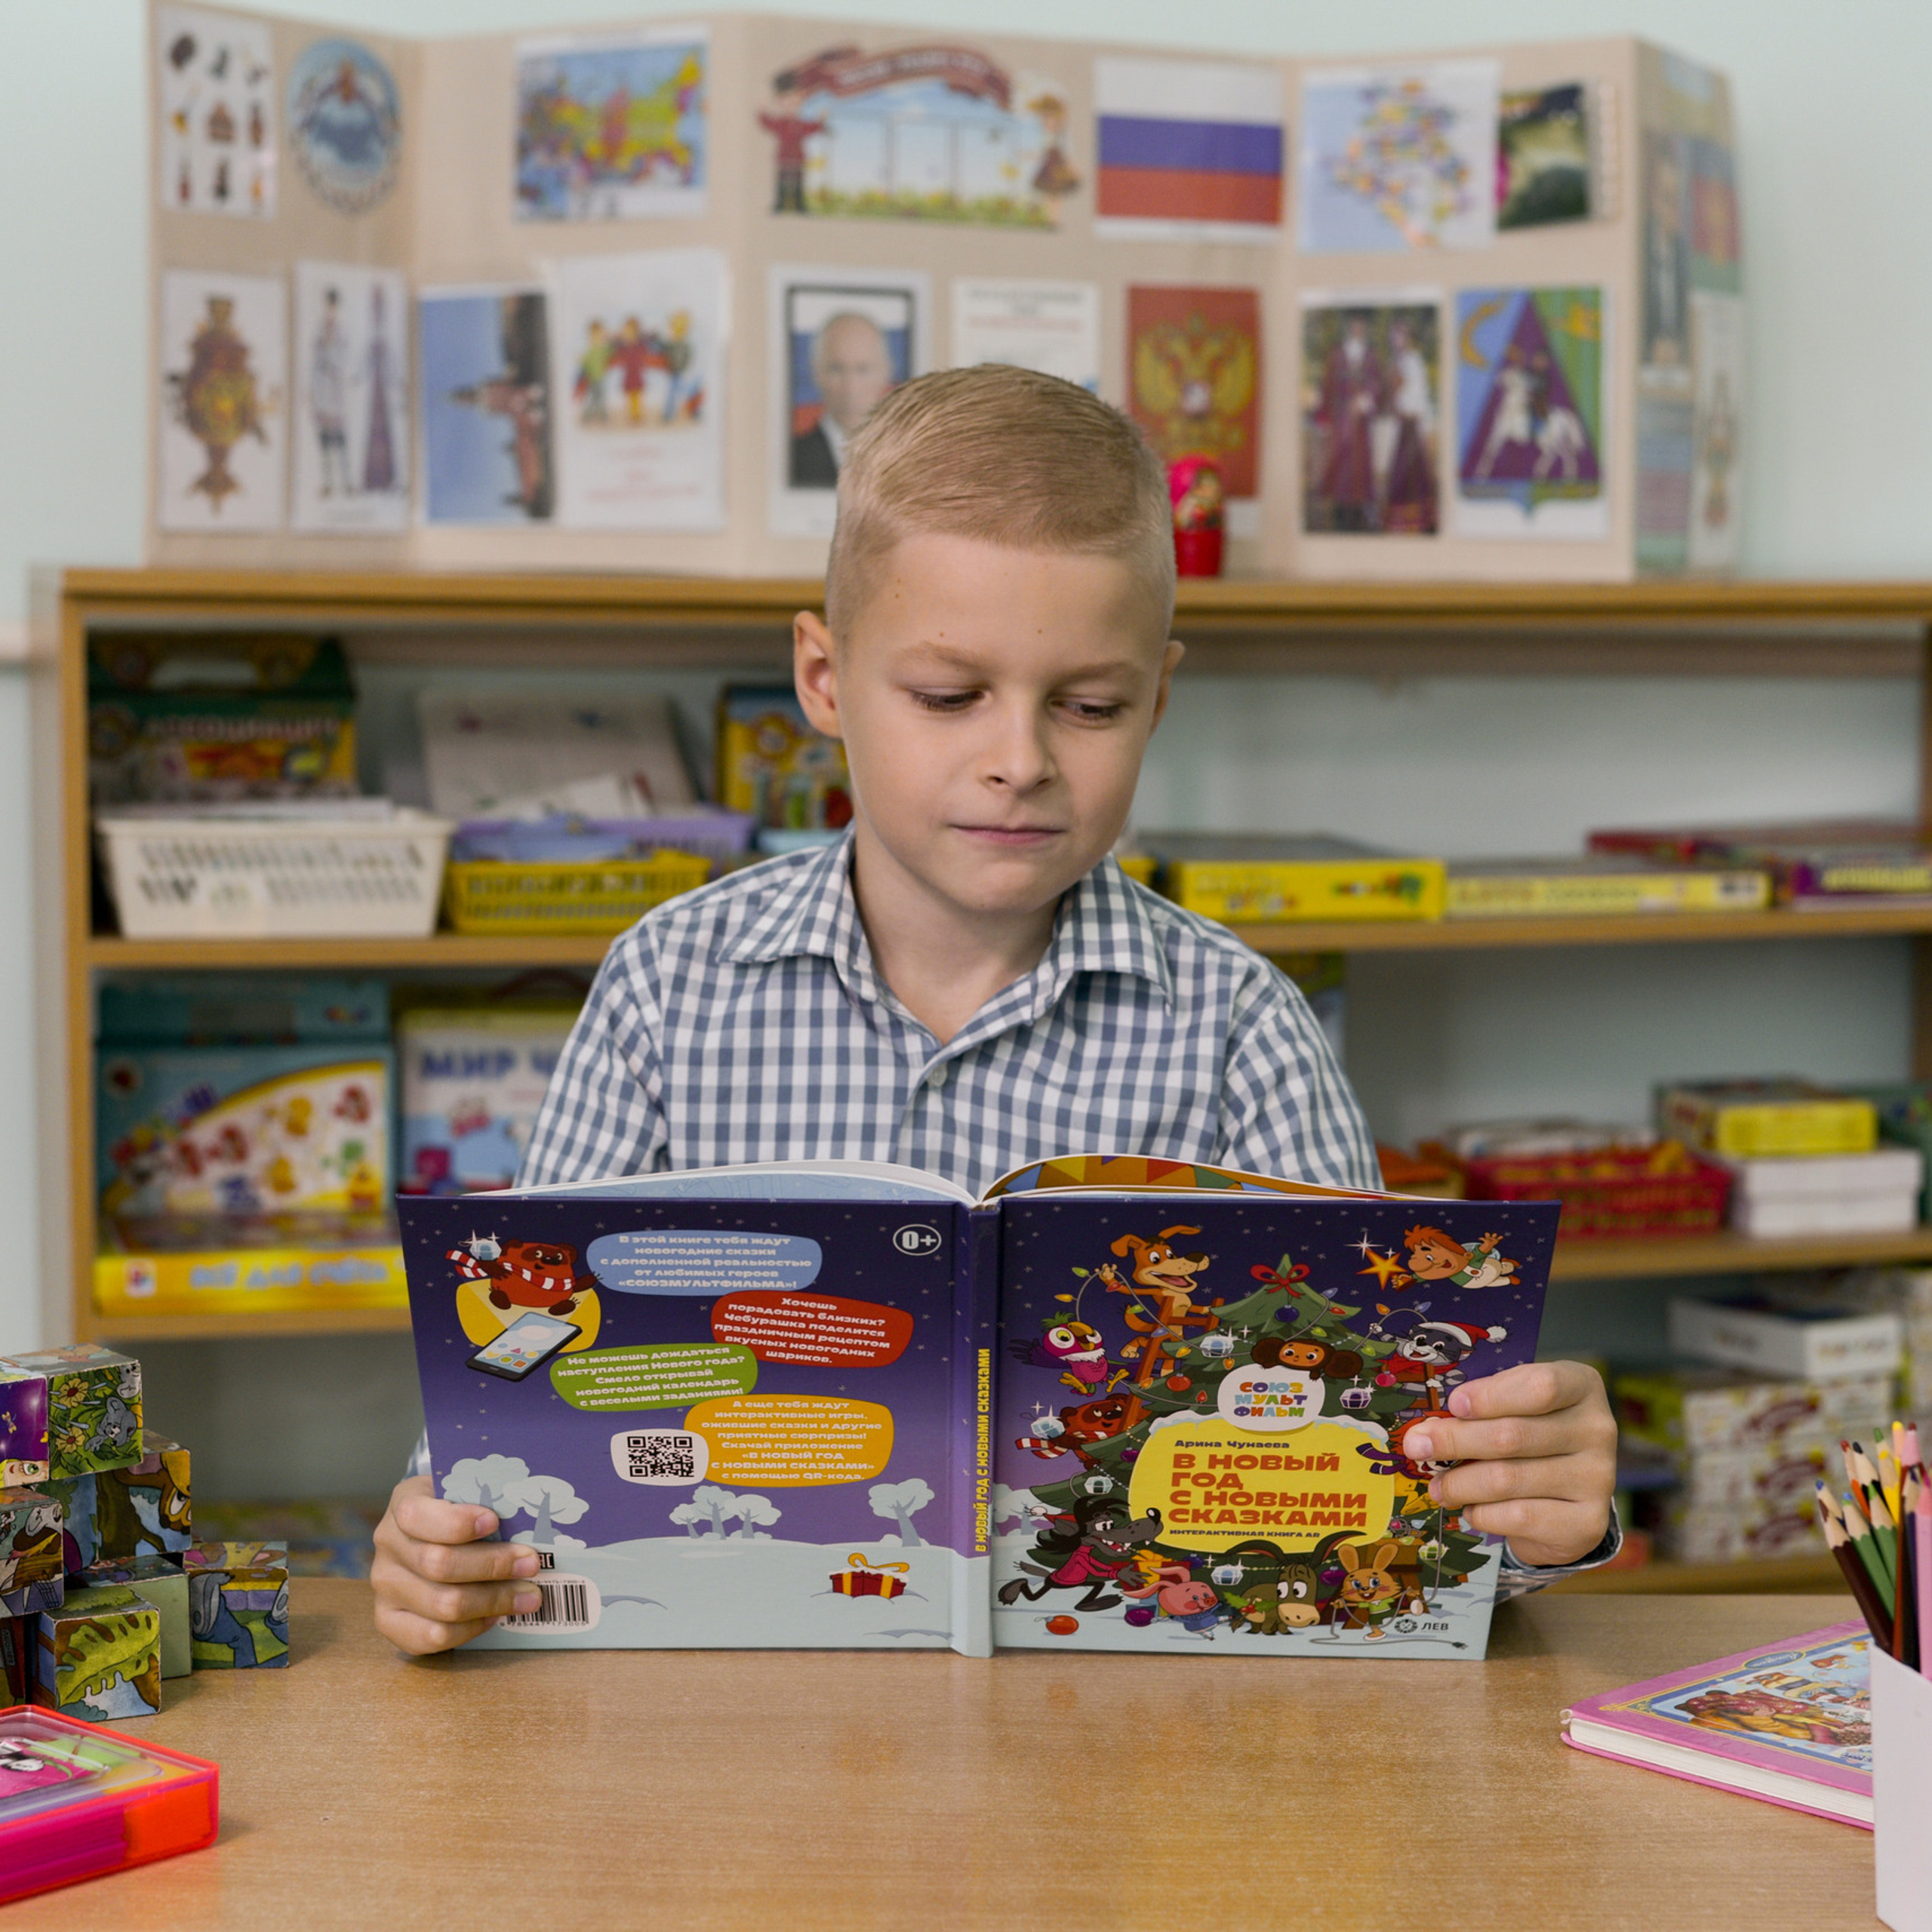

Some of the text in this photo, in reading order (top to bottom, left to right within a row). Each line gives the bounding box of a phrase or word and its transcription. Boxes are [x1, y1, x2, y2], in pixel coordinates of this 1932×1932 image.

[632, 1235, 666, 1244] этой
[669, 1236, 711, 1244] книге
[714, 1235, 748, 1244] тебя
[751, 1237, 791, 1245] ждут
[902, 1231, 937, 1250] 0+
[611, 1258, 711, 1266] дополненной
[714, 1259, 812, 1267] реальностью
[655, 1269, 724, 1277] любимых
[728, 1270, 779, 1278] героев
[782, 1297, 837, 1310] Хочешь
[728, 1303, 885, 1326] порадовать близких?
[724, 1312, 885, 1337] Чебурашка поделится
[714, 1324, 891, 1349] праздничным рецептом
[724, 1335, 875, 1357] вкусных новогодних
[568, 1347, 730, 1365] Не можешь дождаться
[766, 1350, 832, 1364] шариков.
[558, 1355, 745, 1377] наступления Нового года?
[595, 1368, 713, 1384] Смело открывай
[576, 1377, 739, 1396] новогодний календарь
[1239, 1382, 1303, 1393] СОЮЗ
[590, 1394, 660, 1406] веселыми
[663, 1388, 743, 1401] заданиями!
[812, 1401, 849, 1410] ждут
[1235, 1395, 1307, 1405] МУЛЬТ
[1233, 1406, 1305, 1417] ФИЛЬМ
[832, 1423, 881, 1431] другие
[977, 1414, 989, 1466] НОВЫМИ
[1175, 1440, 1290, 1449] Арина Чунаева
[761, 1451, 813, 1460] НОВЫЙ
[1173, 1452, 1340, 1472] В НОВЫЙ
[977, 1468, 989, 1476] С
[976, 1477, 990, 1501] ГОД
[1171, 1472, 1243, 1490] ГОД
[1170, 1490, 1367, 1509] С НОВЫМИ
[974, 1503, 989, 1542] НОВЫЙ
[1168, 1508, 1367, 1527] СКАЗКАМИ
[975, 1544, 987, 1552] В
[1421, 1622, 1449, 1630] ЛЕВ
